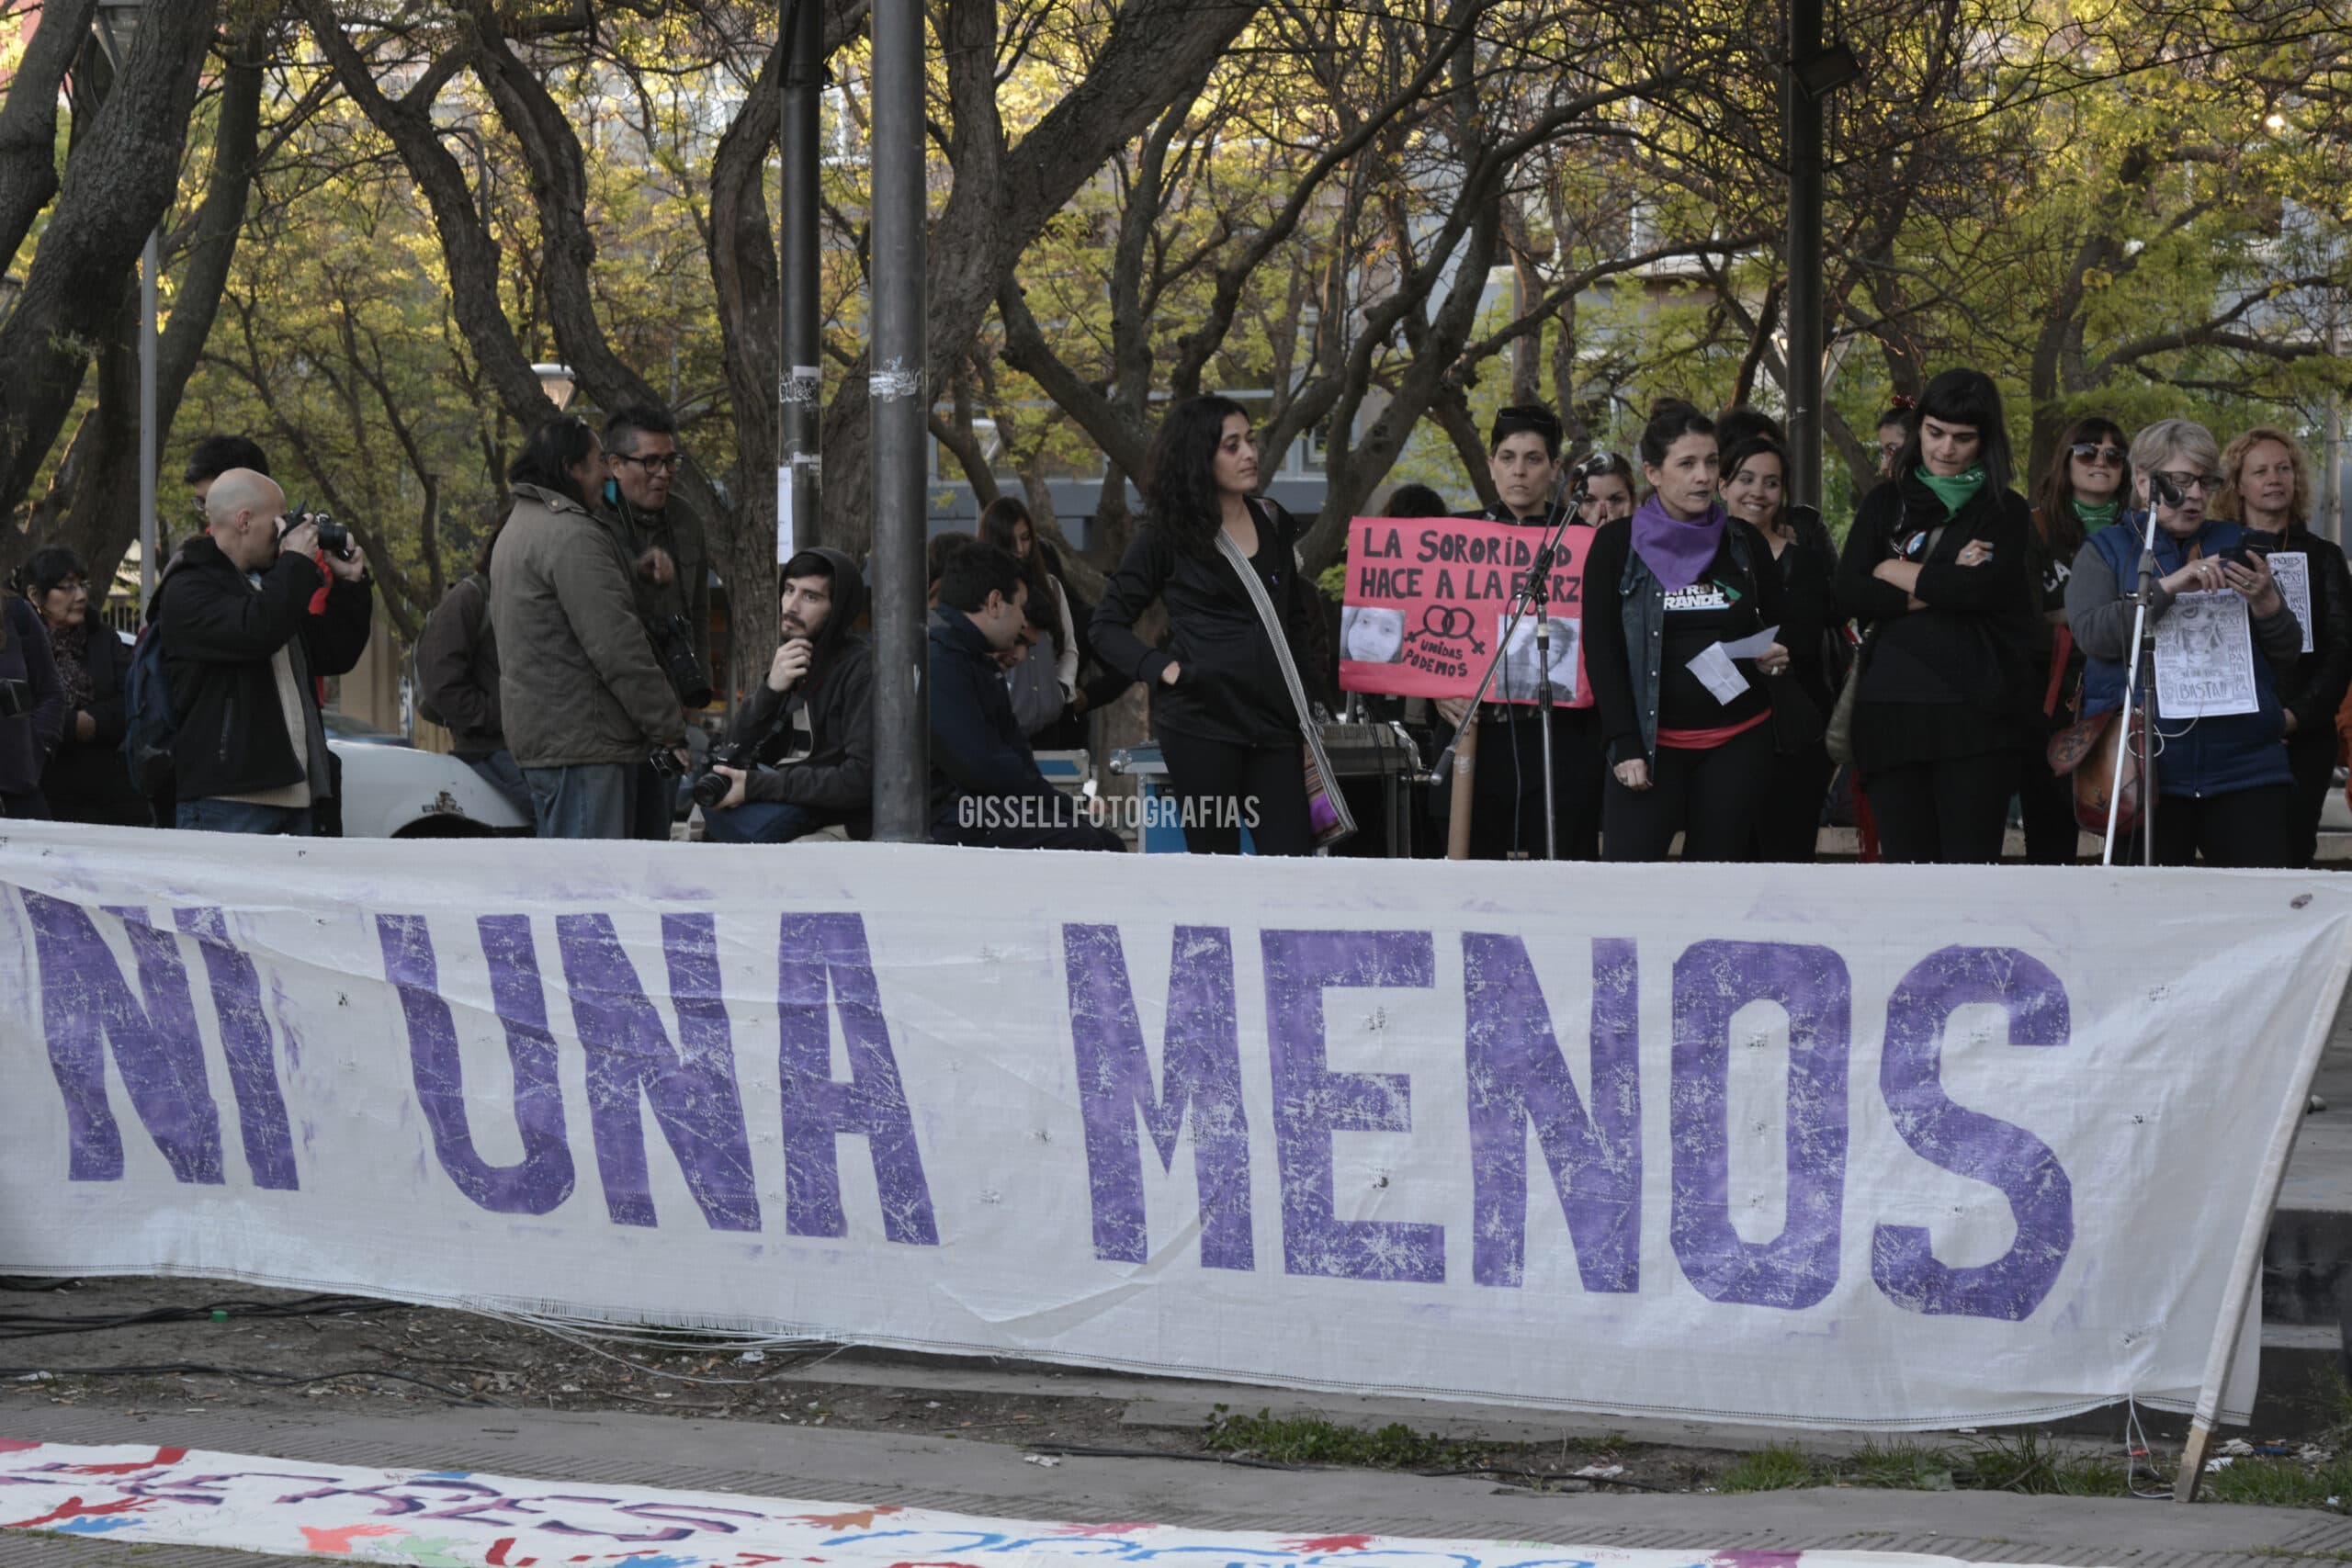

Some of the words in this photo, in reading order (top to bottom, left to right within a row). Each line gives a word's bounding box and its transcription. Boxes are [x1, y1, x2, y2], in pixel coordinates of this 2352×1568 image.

[1363, 527, 1402, 558] LA
[1360, 567, 1423, 598] HACE
[1435, 569, 1454, 599] A
[1465, 570, 1504, 601] LA
[1664, 592, 1724, 610] RANDE
[1403, 649, 1468, 677] PODEMOS
[18, 886, 300, 1190] NI
[376, 911, 940, 1246] UNA
[1062, 922, 2074, 1322] MENOS
